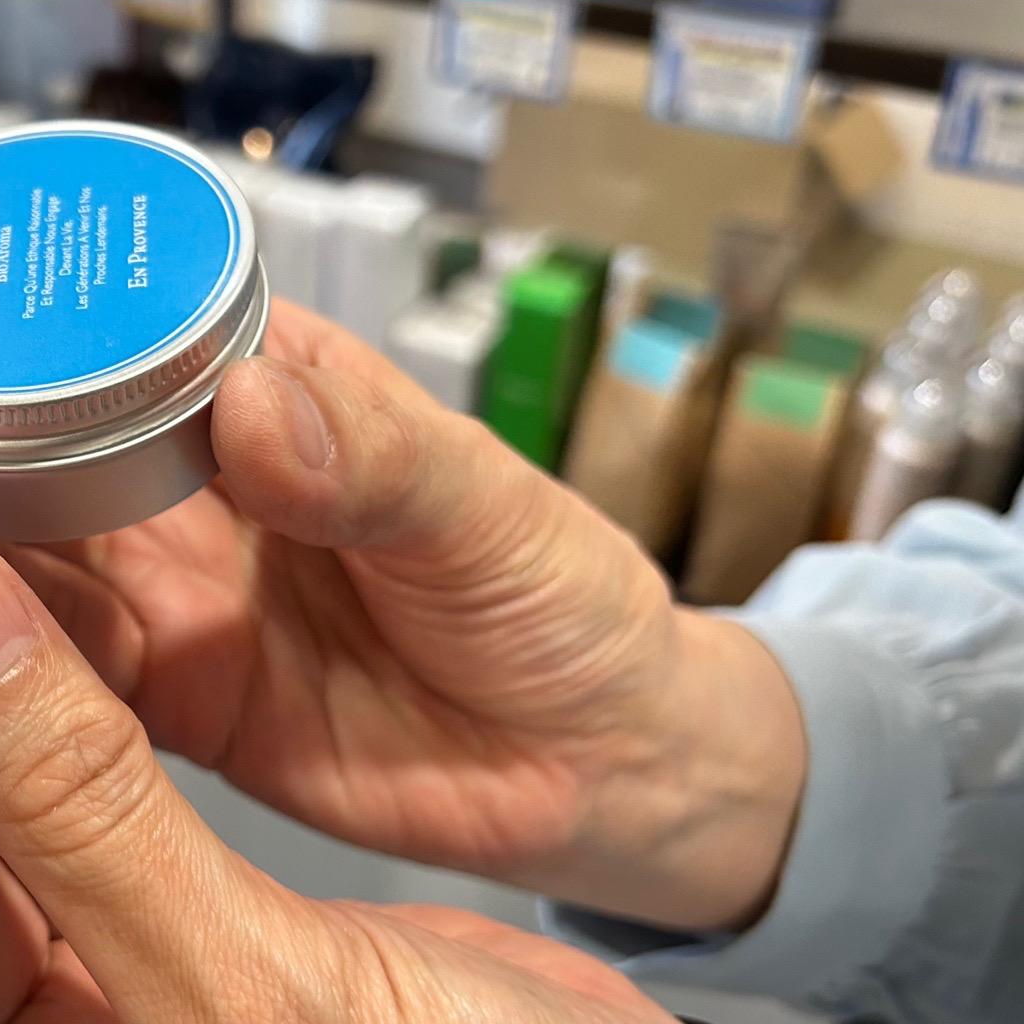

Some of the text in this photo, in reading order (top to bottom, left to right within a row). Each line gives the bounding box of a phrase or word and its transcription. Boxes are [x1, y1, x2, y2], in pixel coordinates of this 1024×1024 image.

[79, 187, 91, 204] Nos
[77, 204, 91, 214] Et
[43, 223, 57, 245] Nous
[78, 213, 91, 235] Venir
[25, 232, 41, 263] Ethique
[61, 234, 73, 246] La
[77, 235, 89, 243] A
[127, 194, 148, 289] EN PROVENCE
[40, 245, 56, 296] Responsable
[58, 246, 73, 277] Devant
[93, 252, 107, 285] Proches
[21, 295, 36, 319] Parce
[39, 295, 53, 306] Et
[75, 293, 89, 310] Les
